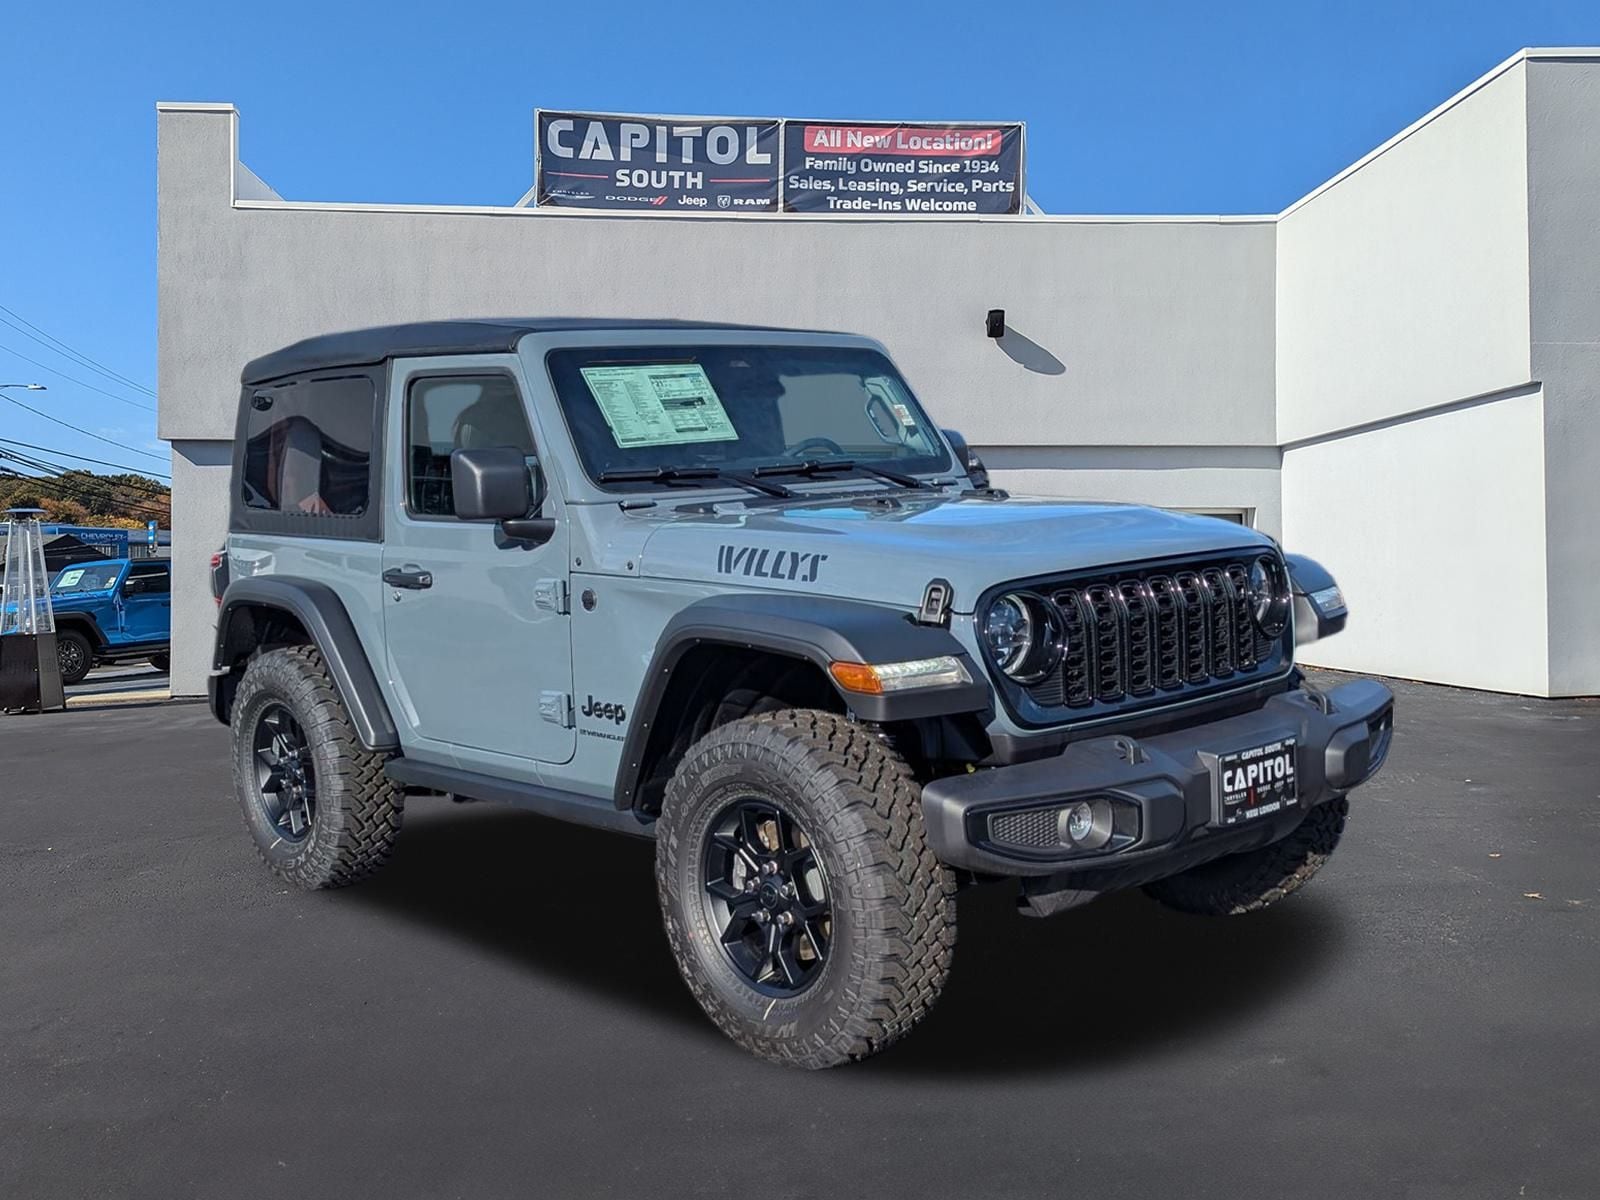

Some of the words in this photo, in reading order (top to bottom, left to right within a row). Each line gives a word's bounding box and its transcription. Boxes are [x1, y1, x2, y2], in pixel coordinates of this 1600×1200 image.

[547, 119, 772, 165] CAPITOL
[813, 130, 841, 148] All
[847, 131, 892, 149] New
[897, 131, 993, 151] Location!
[805, 157, 857, 174] Family
[860, 159, 914, 174] Owned
[918, 160, 961, 174] Since
[963, 160, 1000, 173] 1934
[615, 168, 703, 190] SOUTH
[788, 175, 835, 192] Sales,
[838, 177, 904, 194] Leasing,
[907, 179, 968, 194] Service,
[971, 179, 1015, 193] Parts
[678, 195, 708, 207] Jeep
[733, 198, 771, 206] RAM
[826, 196, 902, 211] Trade-Ins
[905, 198, 977, 211] Welcome
[718, 545, 828, 582] WILLYS
[581, 695, 627, 725] Jeep
[1223, 754, 1294, 793] CAPITOL
